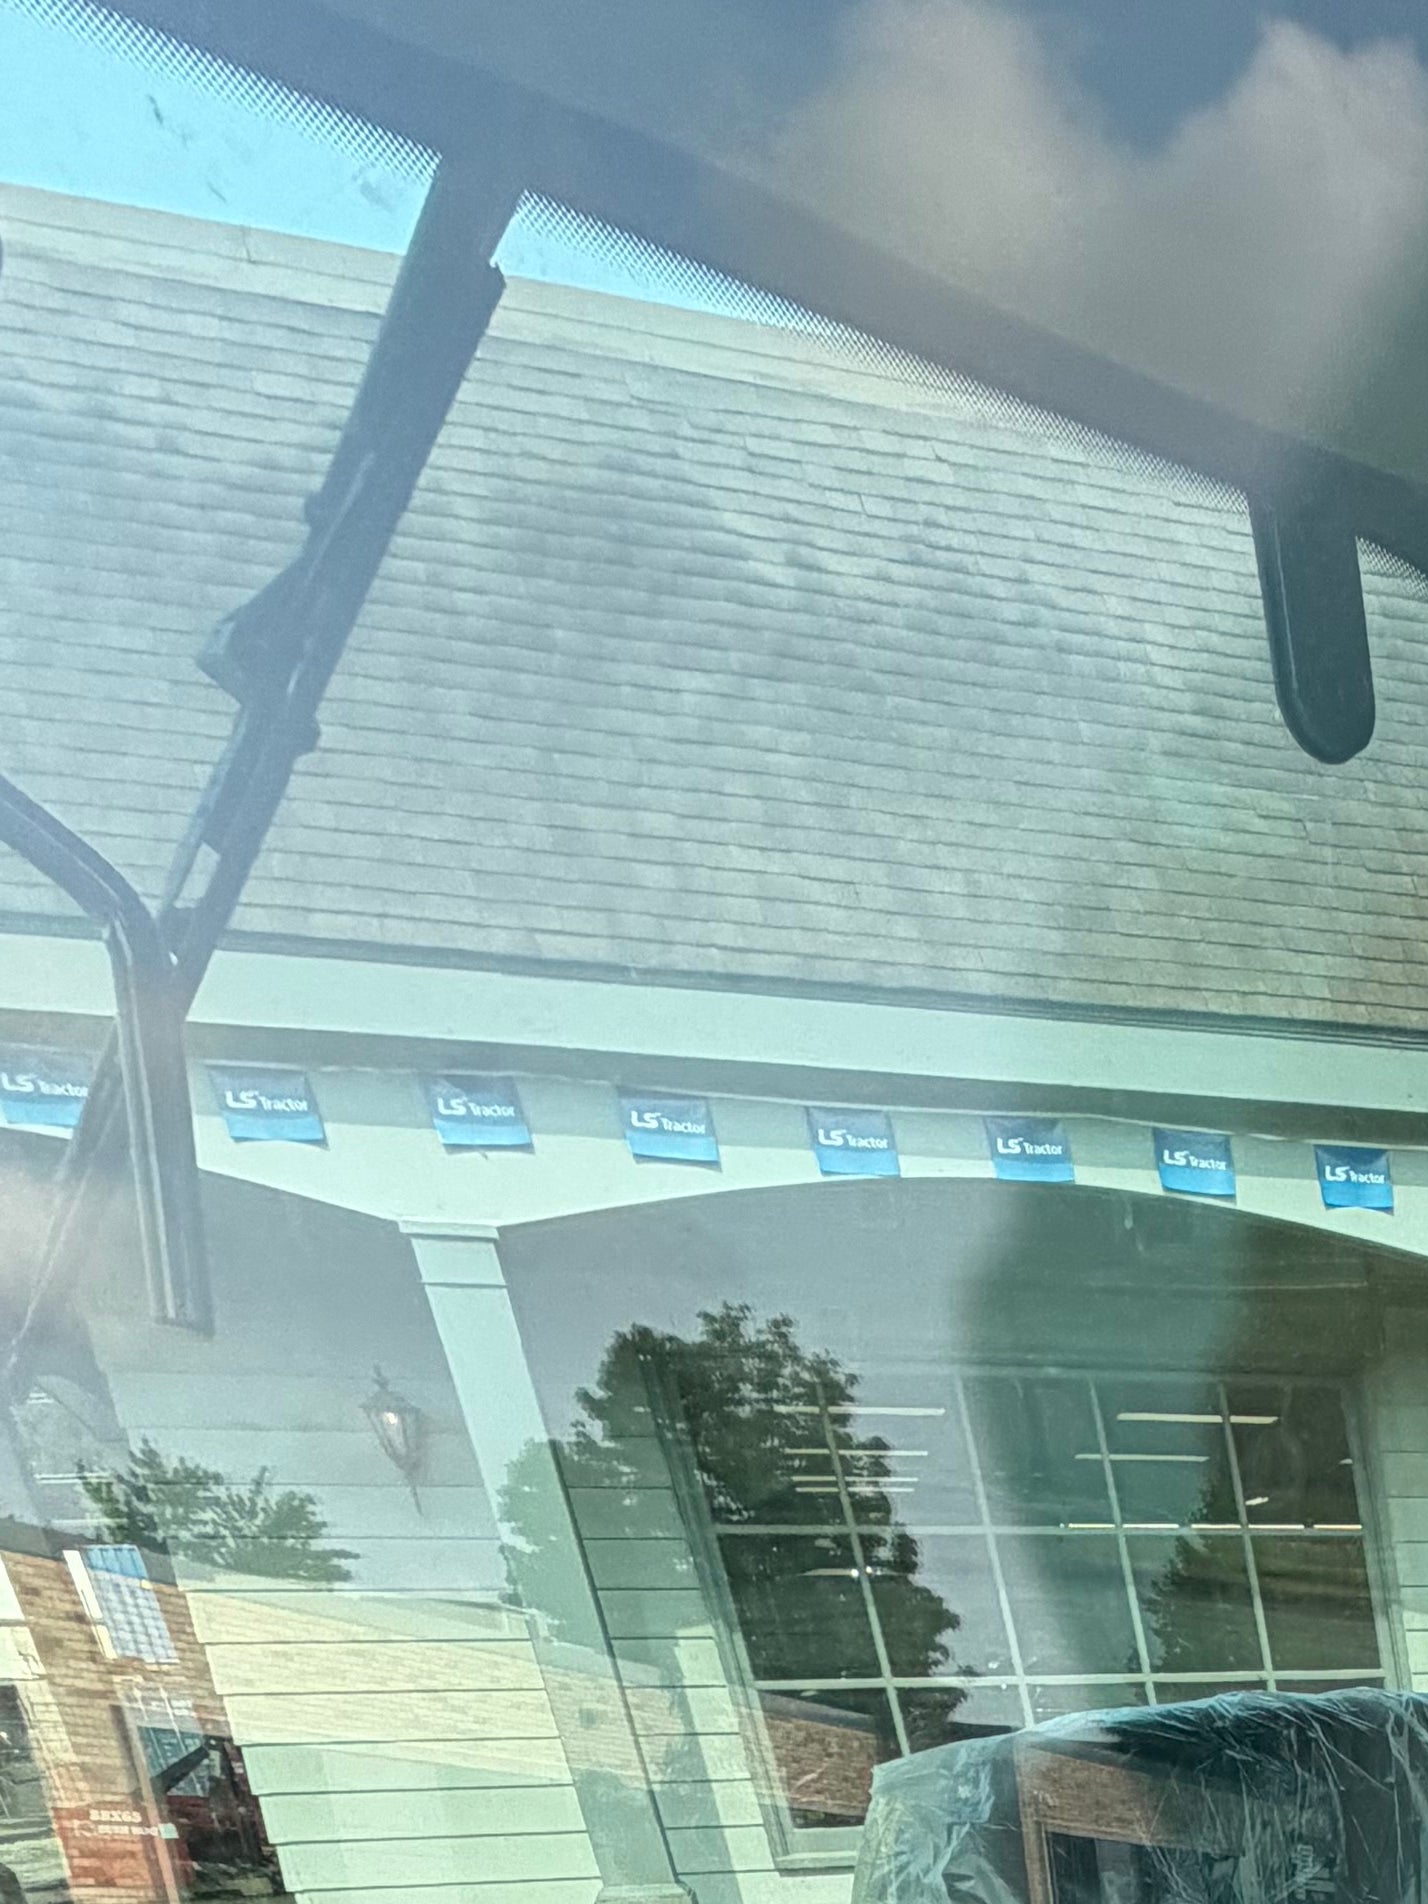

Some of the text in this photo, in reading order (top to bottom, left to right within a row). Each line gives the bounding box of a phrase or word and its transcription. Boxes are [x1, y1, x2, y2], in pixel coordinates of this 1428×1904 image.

[1, 1072, 88, 1097] LS Tractor
[225, 1090, 308, 1111] LS Tractor
[438, 1098, 515, 1117] LS Tractor
[631, 1111, 706, 1134] LS Tractor
[818, 1129, 888, 1149] LS Tractor
[997, 1137, 1062, 1155] LS Tractor
[1163, 1149, 1227, 1170] LS Tractor
[1325, 1165, 1385, 1183] LS Tractor
